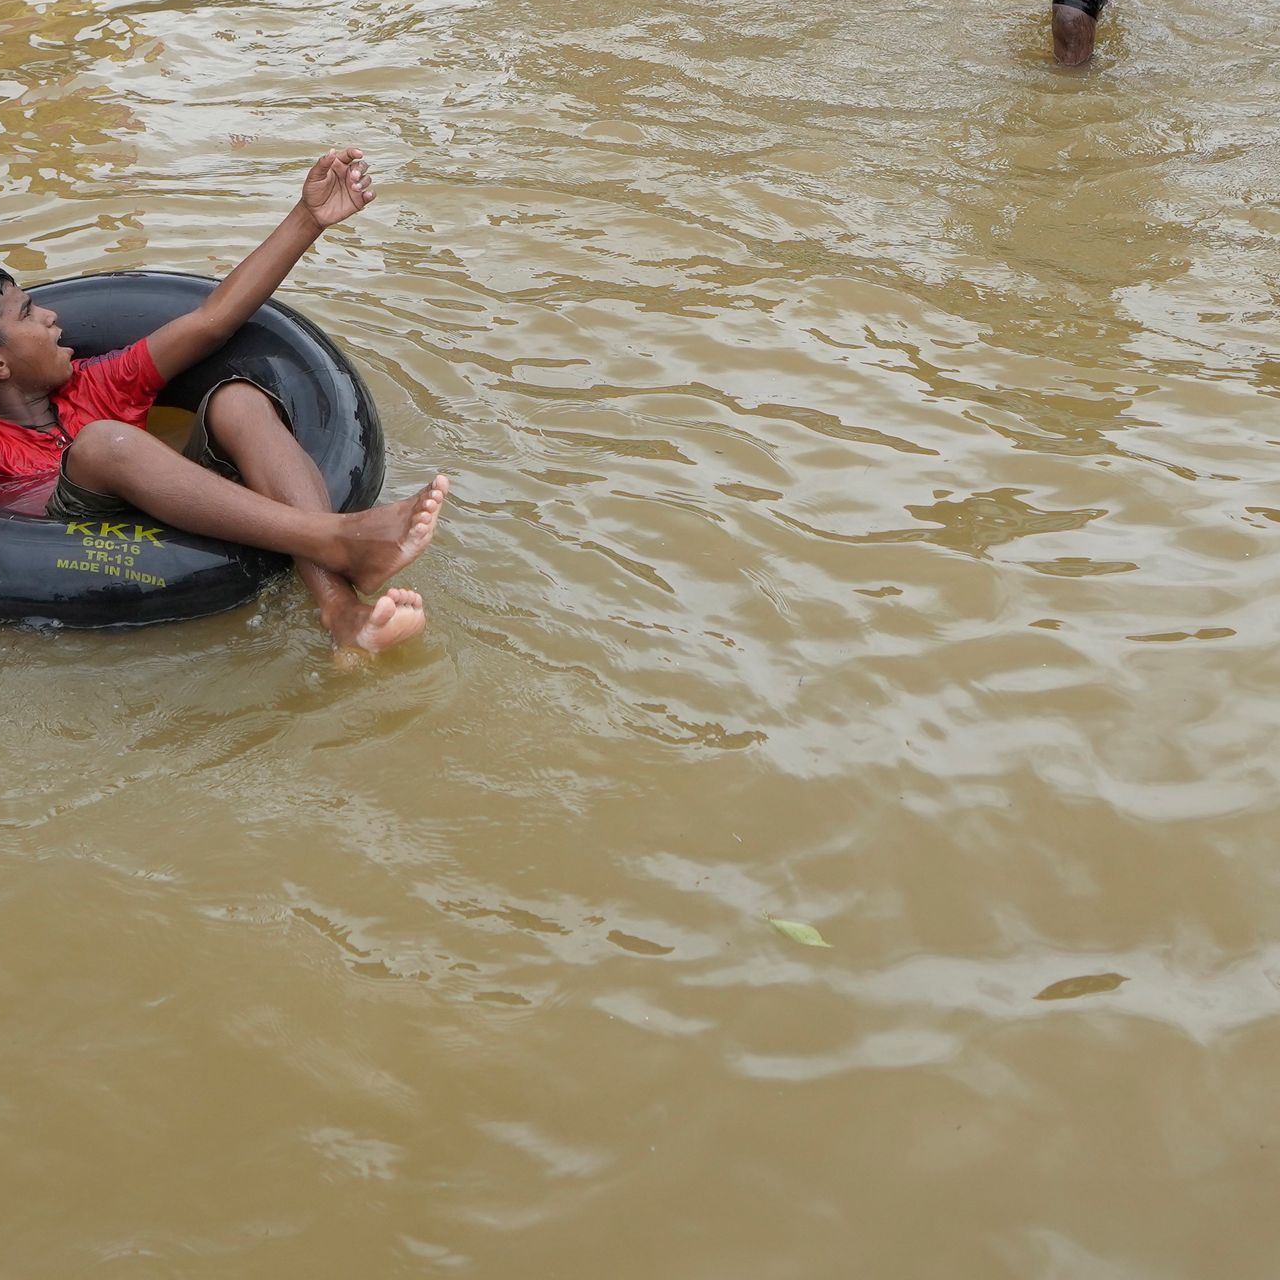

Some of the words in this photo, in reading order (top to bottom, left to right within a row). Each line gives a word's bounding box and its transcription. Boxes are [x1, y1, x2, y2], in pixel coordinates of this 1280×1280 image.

[65, 521, 166, 550] KKK
[85, 550, 135, 567] TR-13
[56, 559, 100, 573] MADE
[104, 564, 121, 577] IN
[124, 569, 167, 588] INDIA
